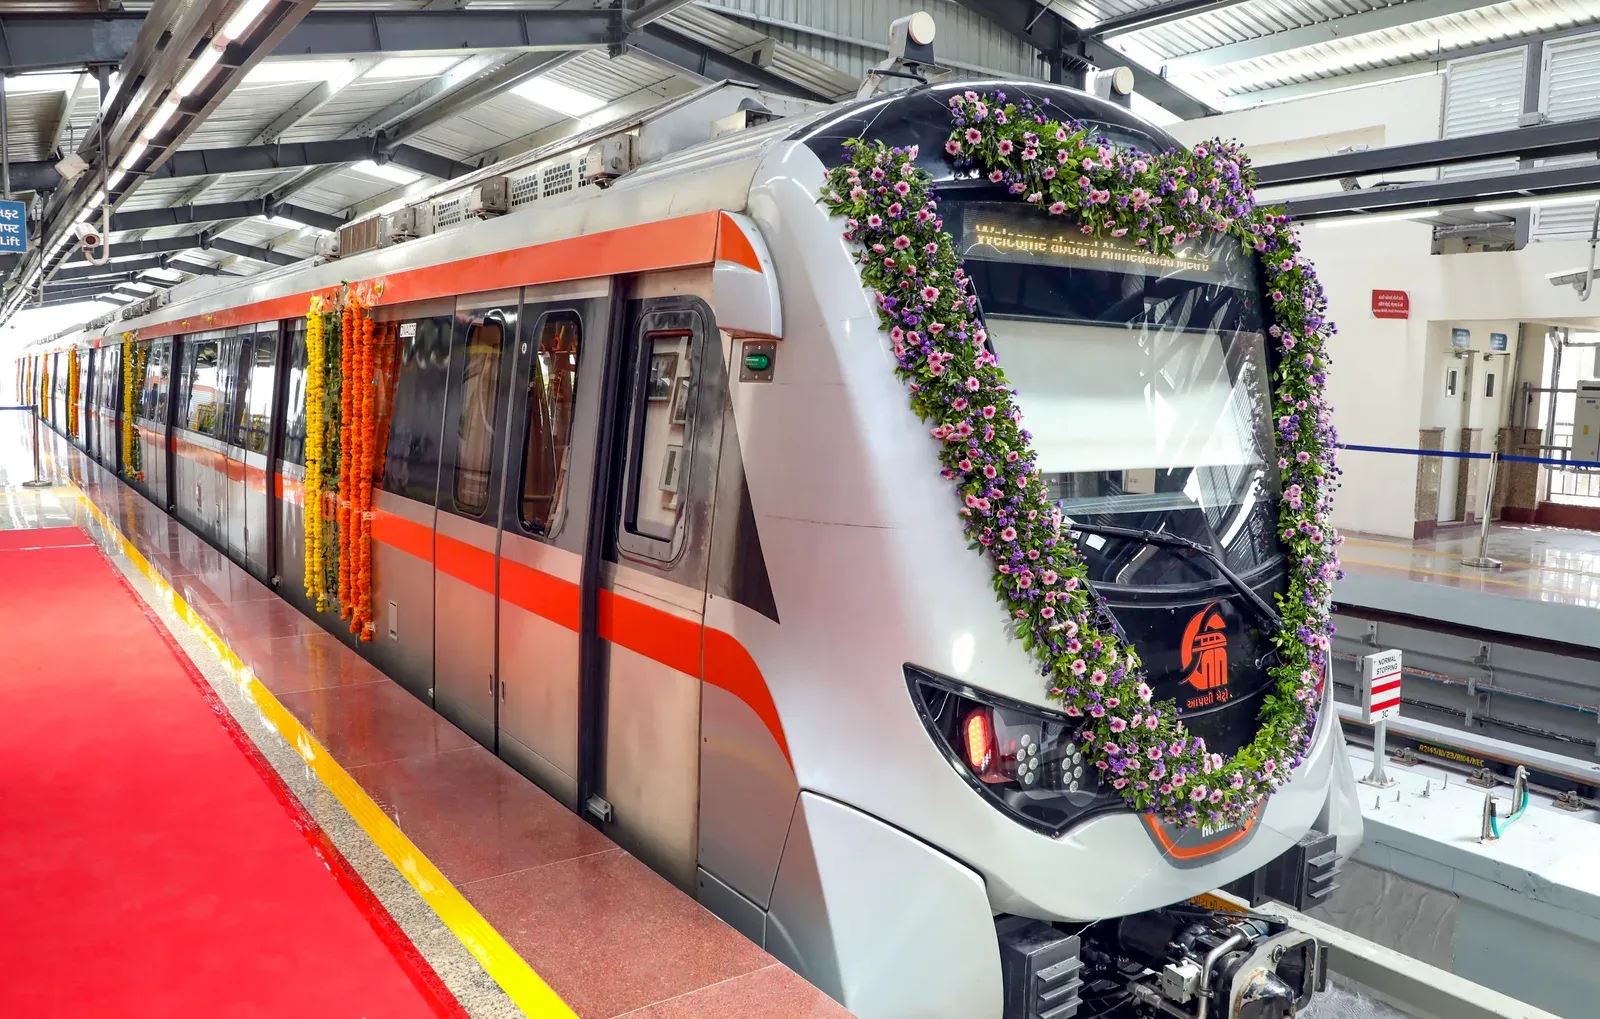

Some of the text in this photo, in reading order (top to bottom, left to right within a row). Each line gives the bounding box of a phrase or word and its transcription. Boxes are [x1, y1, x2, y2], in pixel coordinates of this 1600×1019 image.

[0, 236, 20, 246] Lift
[1378, 655, 1396, 666] NORMAL
[1376, 663, 1398, 675] STOPPING
[1187, 691, 1214, 708] આપણી
[1381, 709, 1389, 718] 3C
